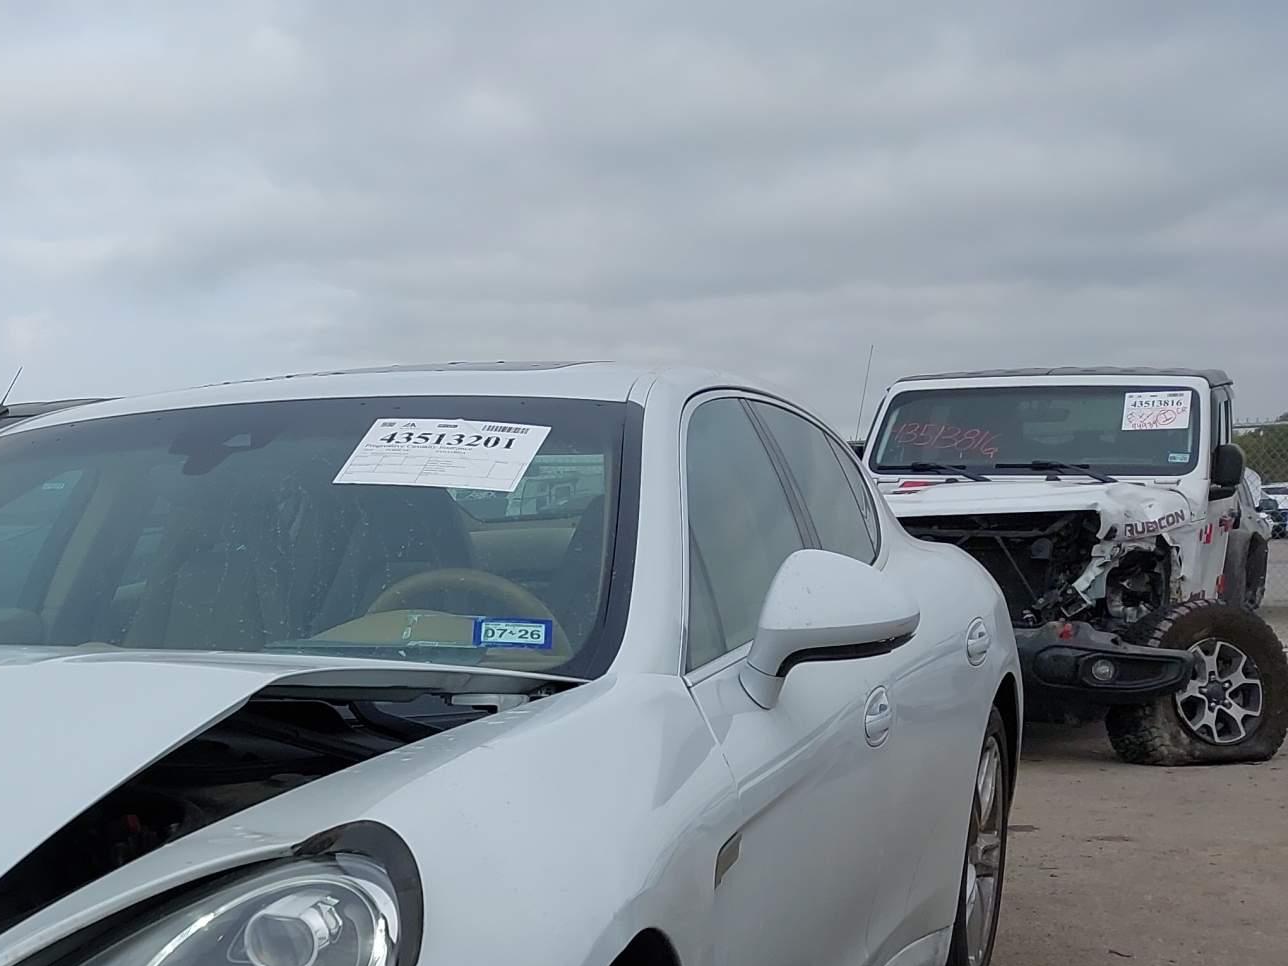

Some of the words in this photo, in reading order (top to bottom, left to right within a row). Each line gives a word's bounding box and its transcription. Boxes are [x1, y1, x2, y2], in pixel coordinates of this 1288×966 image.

[1130, 399, 1183, 408] 43513816
[379, 431, 516, 450] 43513201
[1124, 509, 1185, 537] RUBICON
